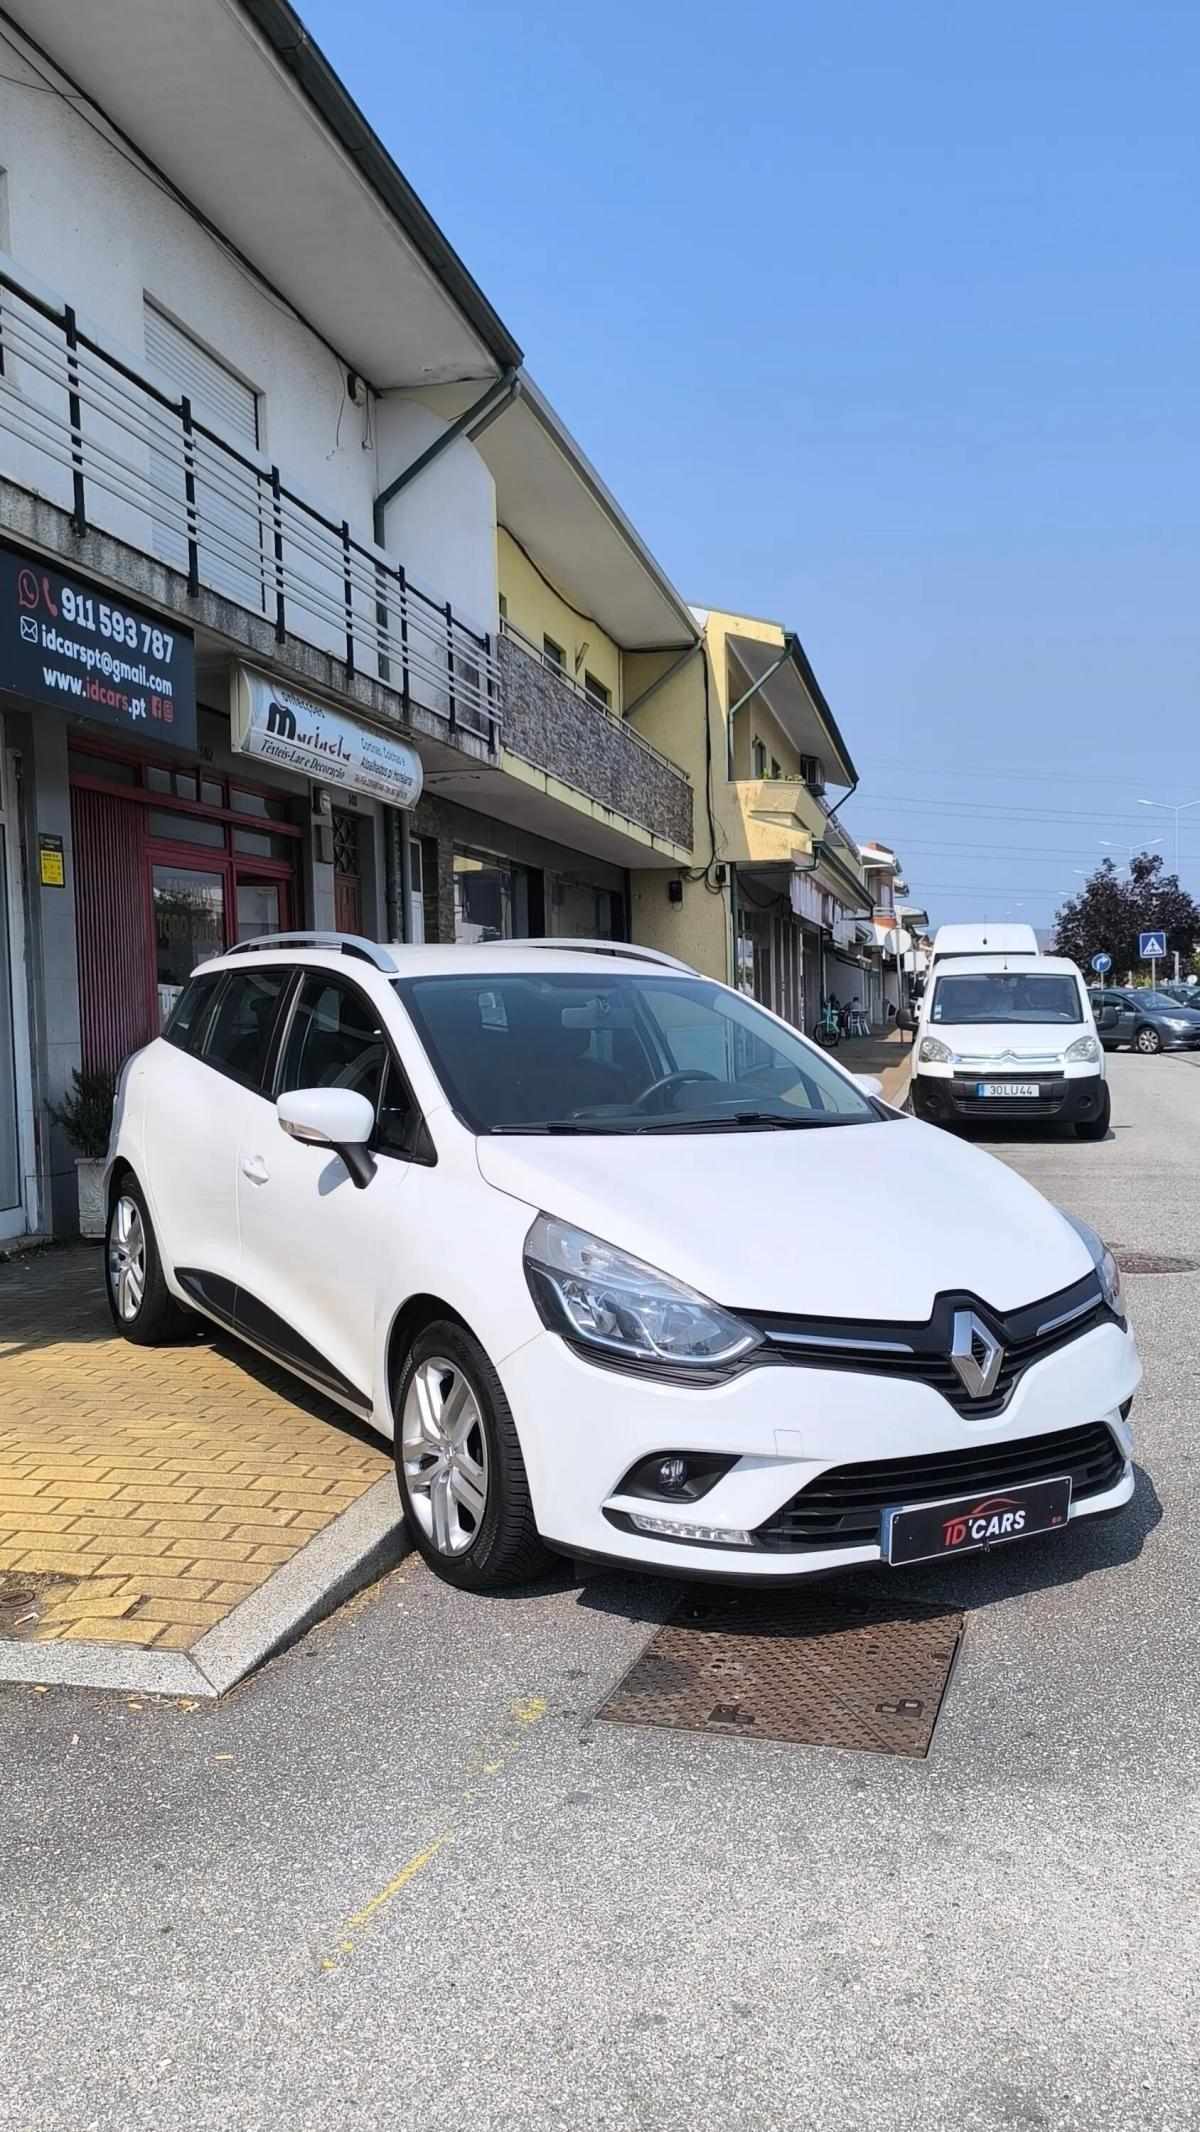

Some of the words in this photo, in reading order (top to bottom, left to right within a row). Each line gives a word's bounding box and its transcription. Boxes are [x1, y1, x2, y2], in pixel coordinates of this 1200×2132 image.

[41, 625, 173, 696] idcarspt@gmail.com
[61, 587, 96, 631] 911
[99, 603, 138, 648] 593
[141, 625, 174, 664] 787
[42, 667, 147, 720] www.idcars.pt
